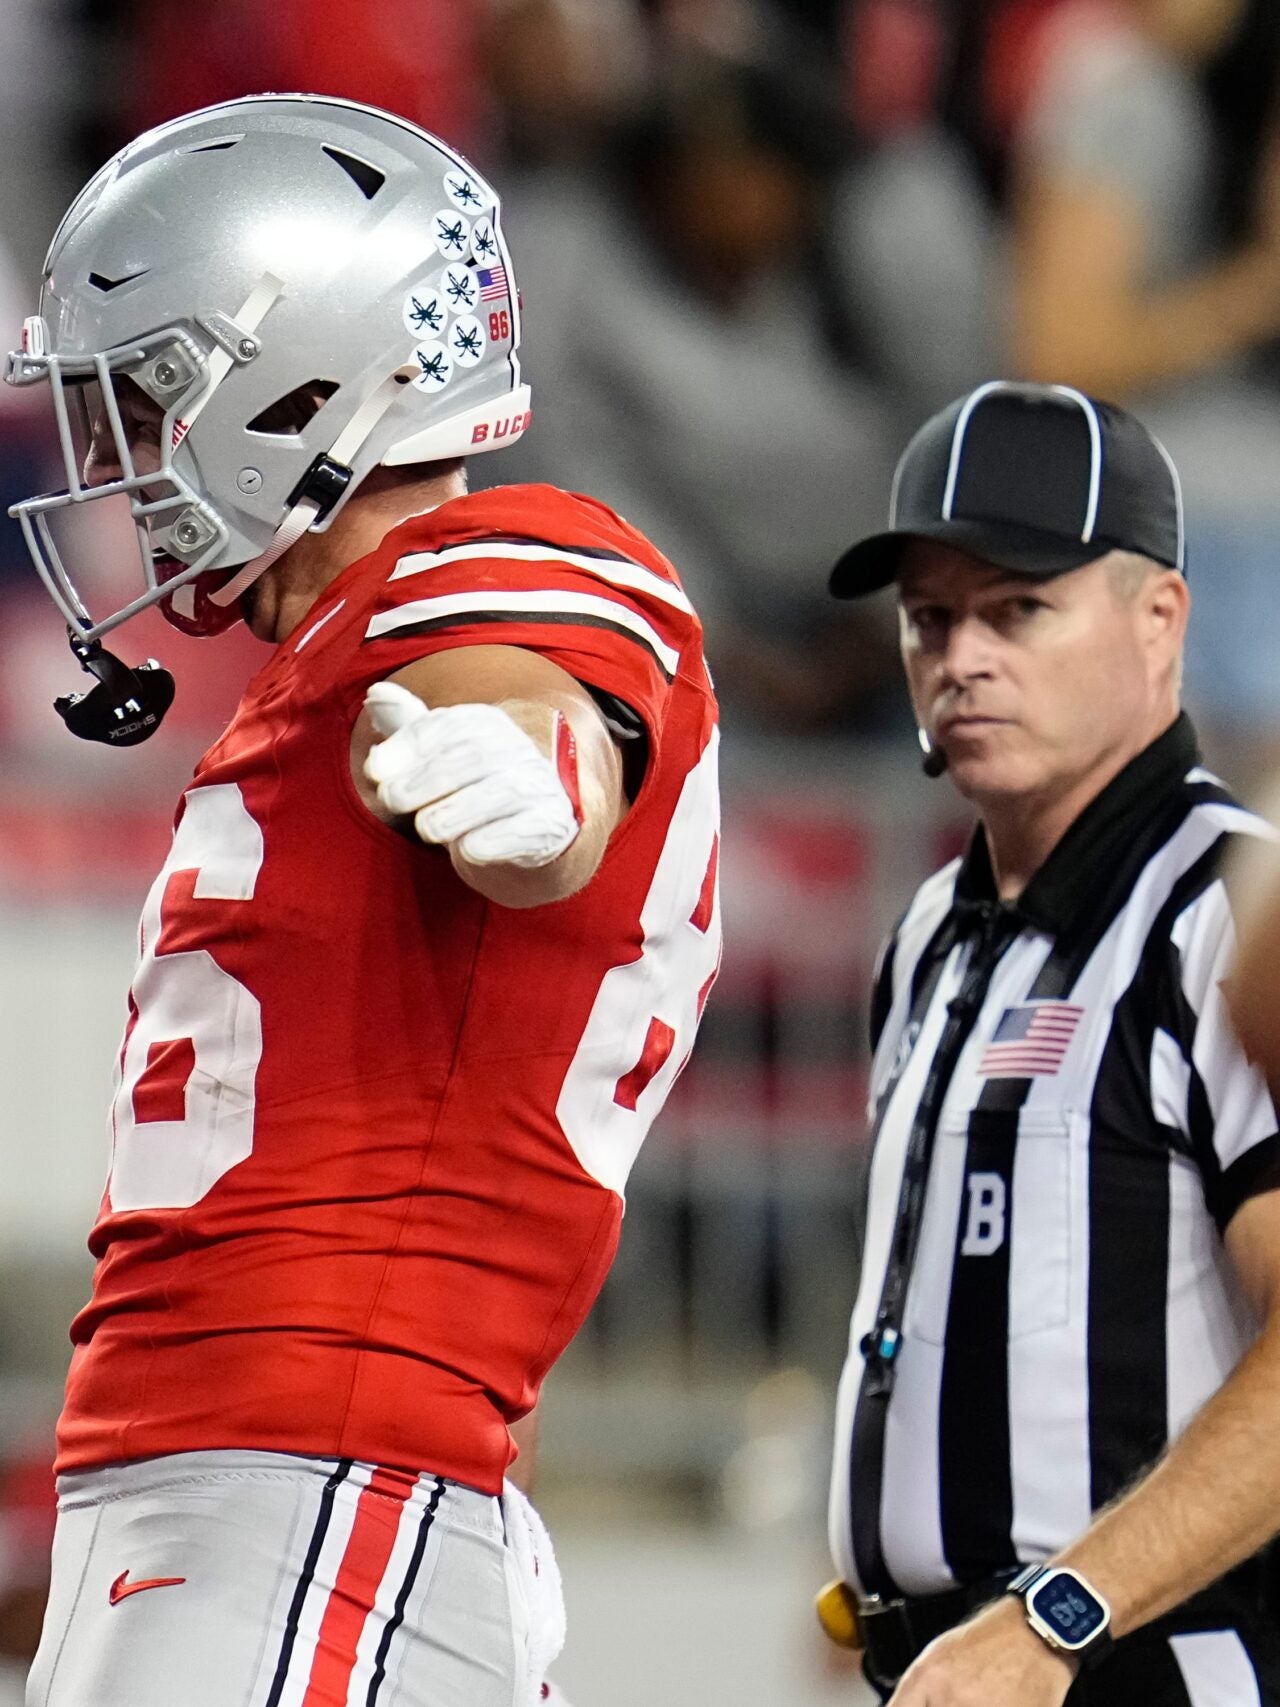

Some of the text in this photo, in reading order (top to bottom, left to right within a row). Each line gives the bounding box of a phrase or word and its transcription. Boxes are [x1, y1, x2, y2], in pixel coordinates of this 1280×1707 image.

[489, 310, 508, 341] 86
[112, 782, 264, 1213] 6
[555, 724, 722, 1195] 8
[961, 1172, 1006, 1256] B
